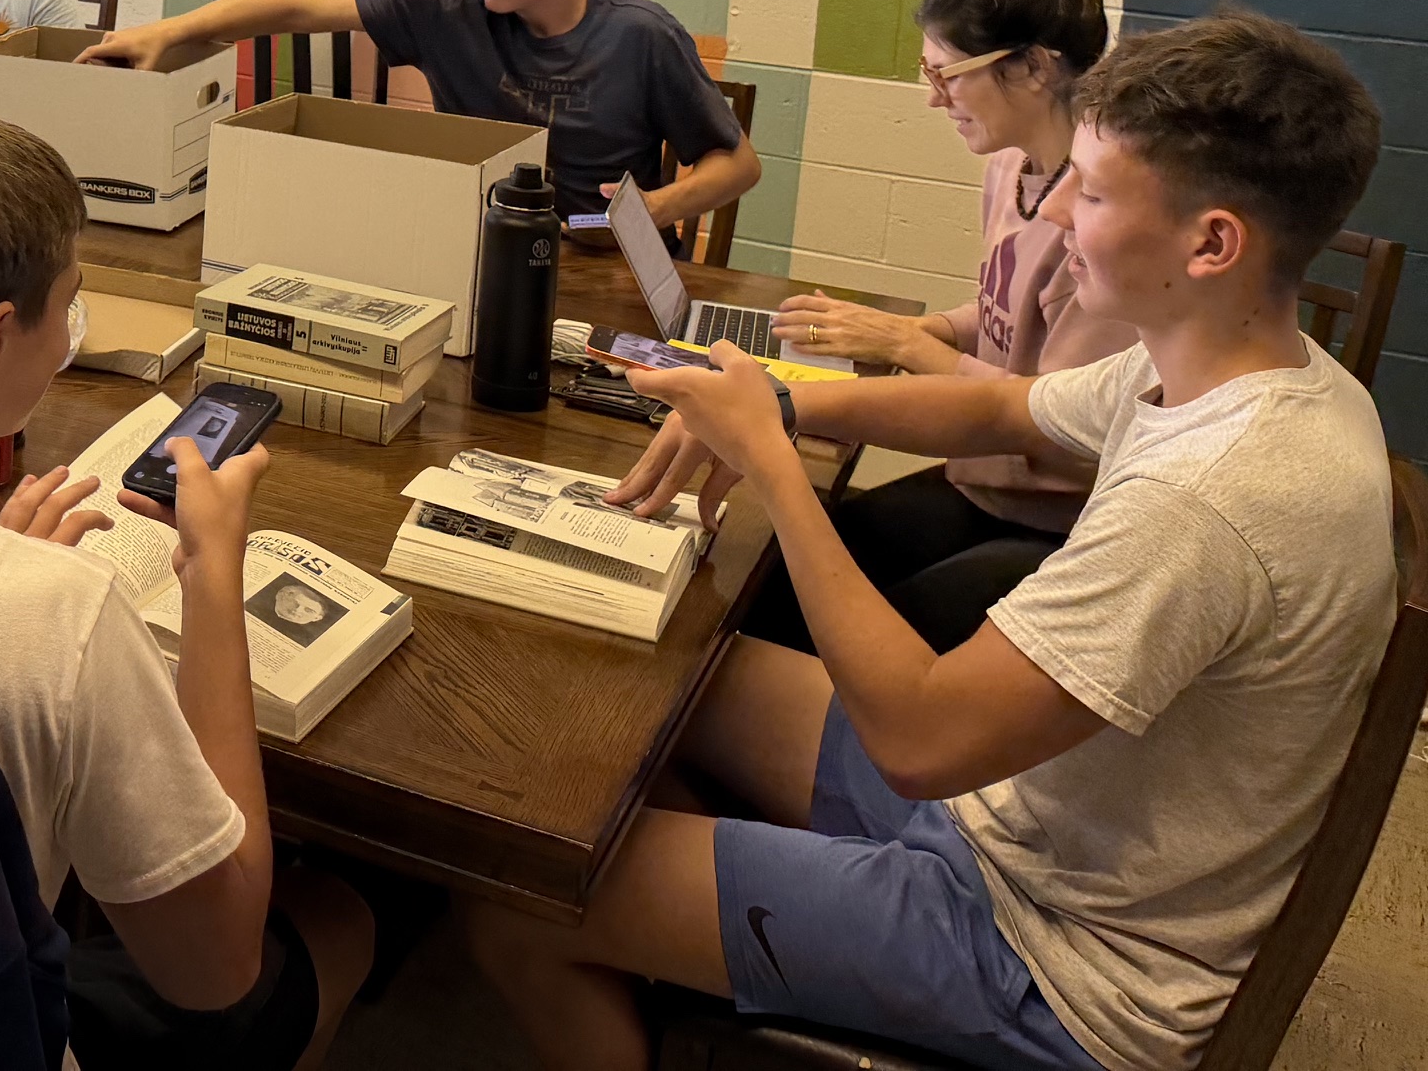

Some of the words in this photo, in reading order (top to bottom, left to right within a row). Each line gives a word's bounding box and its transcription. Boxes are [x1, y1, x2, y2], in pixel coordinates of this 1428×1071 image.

[79, 181, 128, 196] BANKERS
[128, 188, 151, 200] BOX
[237, 311, 277, 328] LIETUVOS
[227, 319, 277, 338] BAŽNYČIOS
[311, 339, 361, 356] arkivyskupija
[330, 333, 362, 347] Vilniaus
